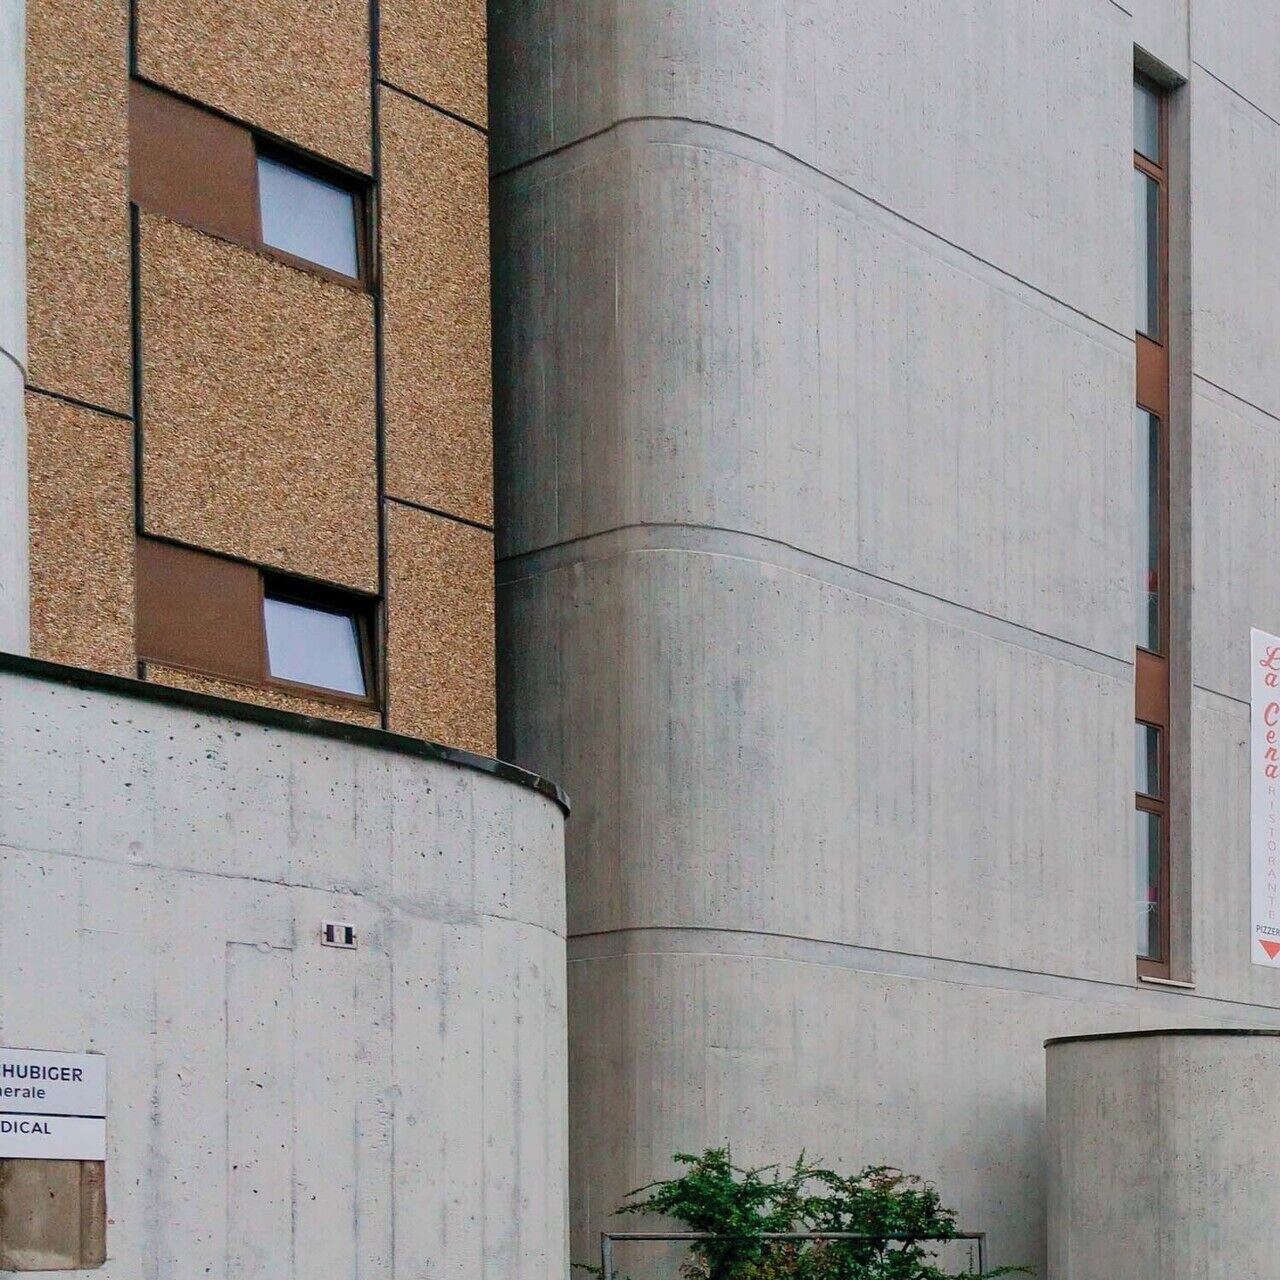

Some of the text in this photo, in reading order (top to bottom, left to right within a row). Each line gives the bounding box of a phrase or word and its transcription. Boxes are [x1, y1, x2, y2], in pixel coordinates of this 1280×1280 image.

[1264, 702, 1280, 778] Cena
[1268, 785, 1277, 920] RISTORANTE
[0, 1064, 83, 1082] HUBIGER
